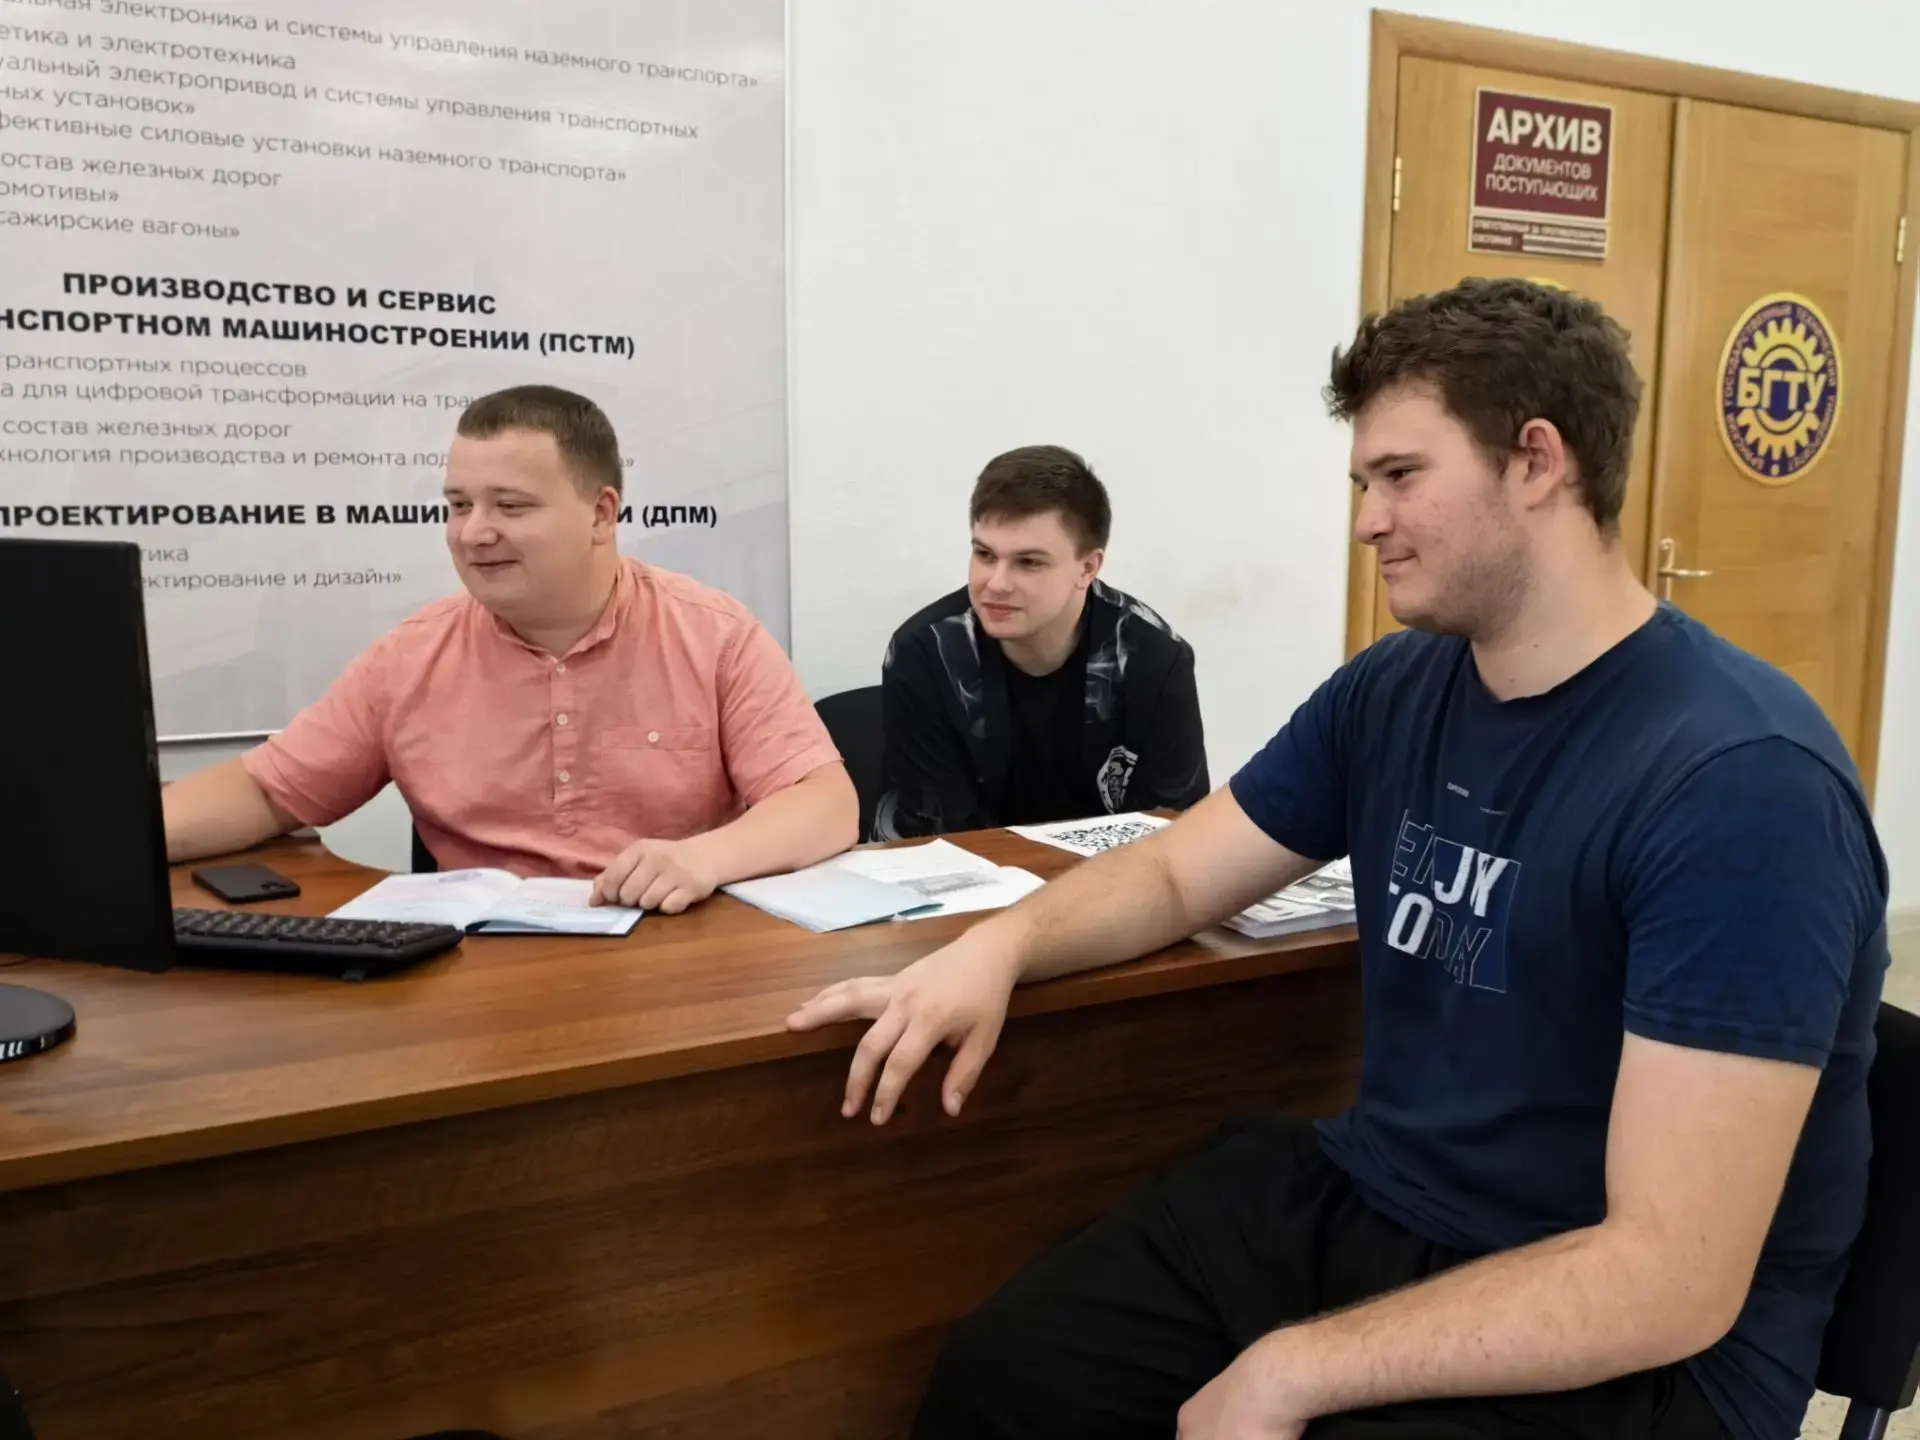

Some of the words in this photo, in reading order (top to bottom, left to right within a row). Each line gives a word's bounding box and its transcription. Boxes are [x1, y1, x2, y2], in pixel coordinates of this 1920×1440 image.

[77, 33, 92, 48] и
[100, 35, 297, 71] электротехника
[100, 0, 258, 31] электроника
[265, 19, 279, 32] и
[287, 20, 383, 44] системы
[390, 32, 518, 61] управления
[524, 49, 631, 74] наземного
[637, 62, 760, 88] транспорта»
[0, 56, 100, 79] альный
[109, 65, 297, 100] электропривод
[304, 86, 318, 100] и
[325, 87, 419, 110] системы
[426, 97, 551, 124] управления
[558, 111, 699, 139] транспортных
[52, 89, 196, 116] установок»
[1486, 107, 1603, 155] АРХИВ
[140, 124, 245, 148] силовые
[252, 133, 371, 160] установки
[379, 147, 492, 171] наземного
[499, 156, 626, 183] транспорта»
[1493, 153, 1592, 181] ДОКУМЕНТОВ
[82, 158, 205, 183] железных
[212, 169, 282, 189] дорог
[1485, 173, 1598, 201] ПОСТУПАЮЩИХ
[142, 219, 240, 240] вагоны»
[63, 272, 337, 307] ПРОИЗВОДСТВО
[346, 287, 367, 308] И
[378, 290, 496, 315] СЕРВИС
[222, 317, 530, 351] МАШИНОСТРОЕНИИ
[539, 333, 635, 359] (ПСТМ)
[0, 353, 172, 374] ранспортных
[180, 359, 307, 378] процессов
[22, 382, 67, 400] для
[76, 380, 202, 403] цифровой
[212, 386, 396, 408] трансформации
[402, 394, 427, 408] на
[434, 394, 475, 411] тра
[1736, 366, 1827, 412] БГТУ
[3, 419, 88, 436] состав
[97, 420, 217, 439] железных
[223, 422, 293, 441] дорог
[120, 449, 285, 467] производства
[293, 450, 306, 465] и
[314, 450, 406, 467] ремонта
[317, 504, 336, 525] В
[642, 505, 718, 528] (ДПМ)
[293, 573, 307, 586] и
[314, 568, 402, 586] дизайн»
